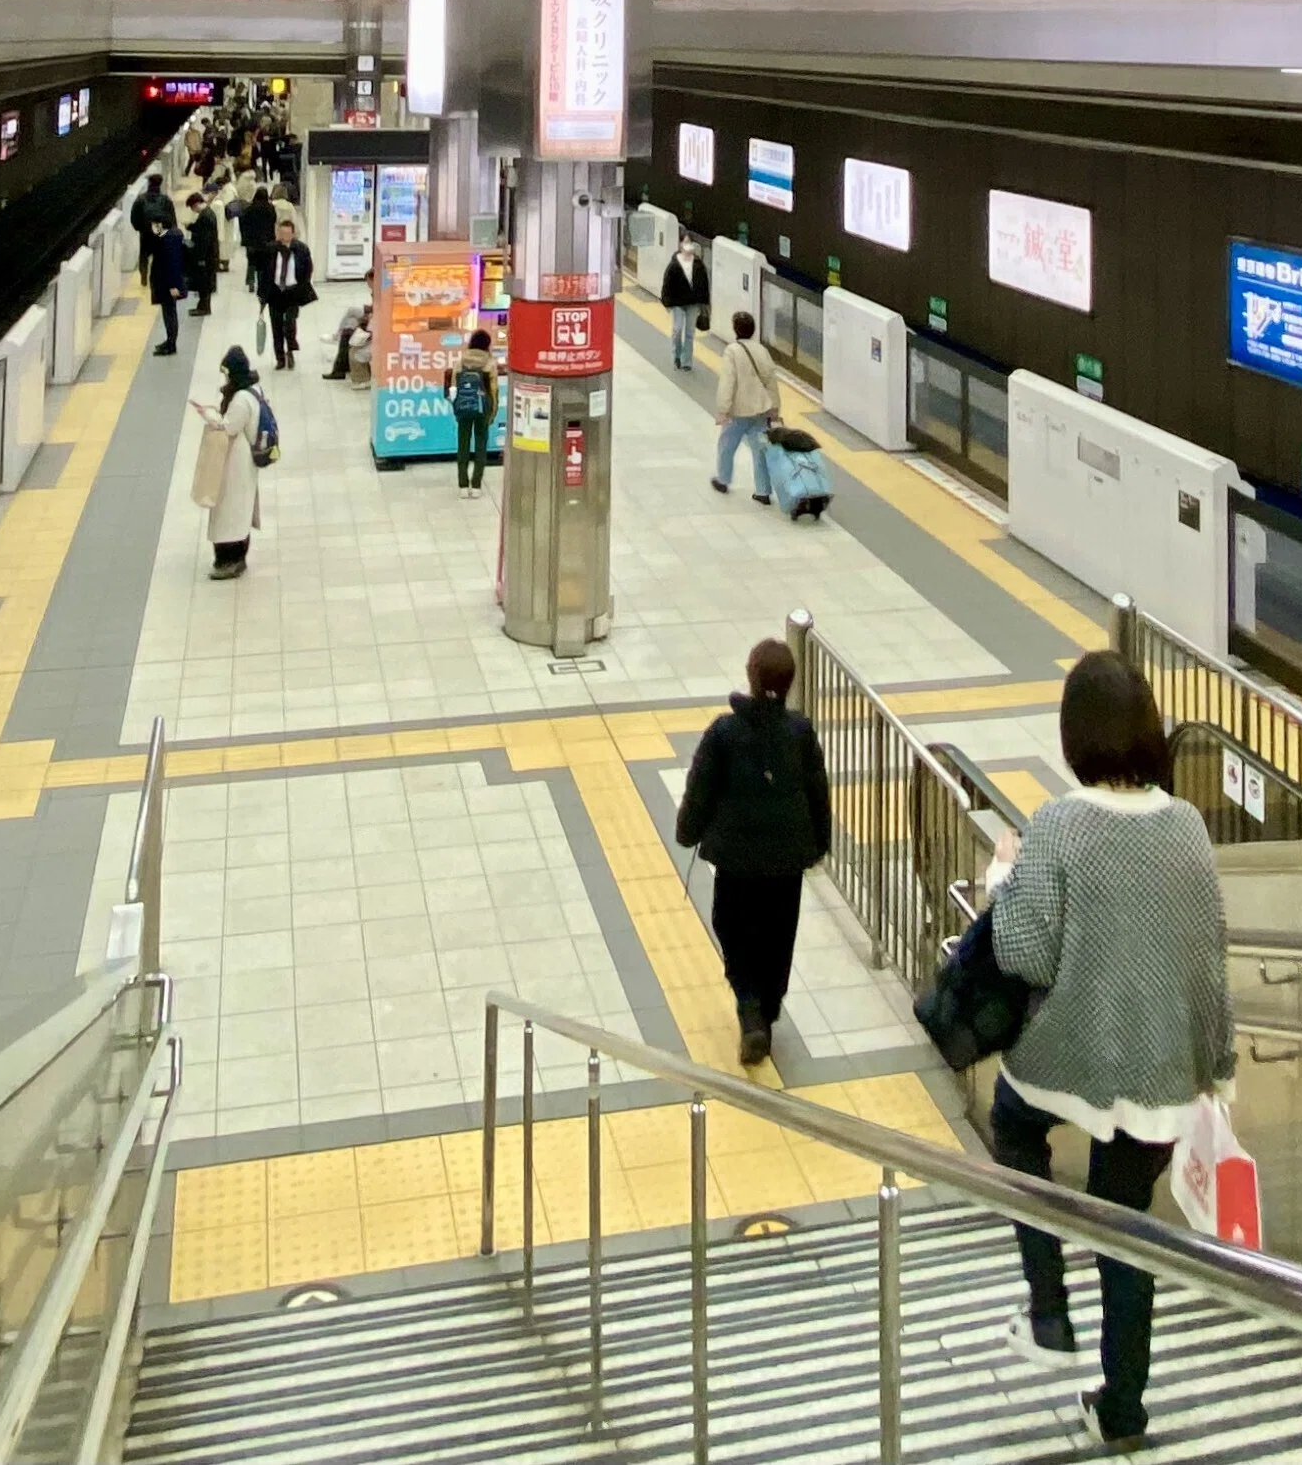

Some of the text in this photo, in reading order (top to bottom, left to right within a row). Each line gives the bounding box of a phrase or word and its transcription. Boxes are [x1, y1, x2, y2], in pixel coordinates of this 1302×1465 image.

[555, 311, 588, 322] STOP
[386, 350, 463, 372] FRESH
[384, 397, 456, 418] ORAN
